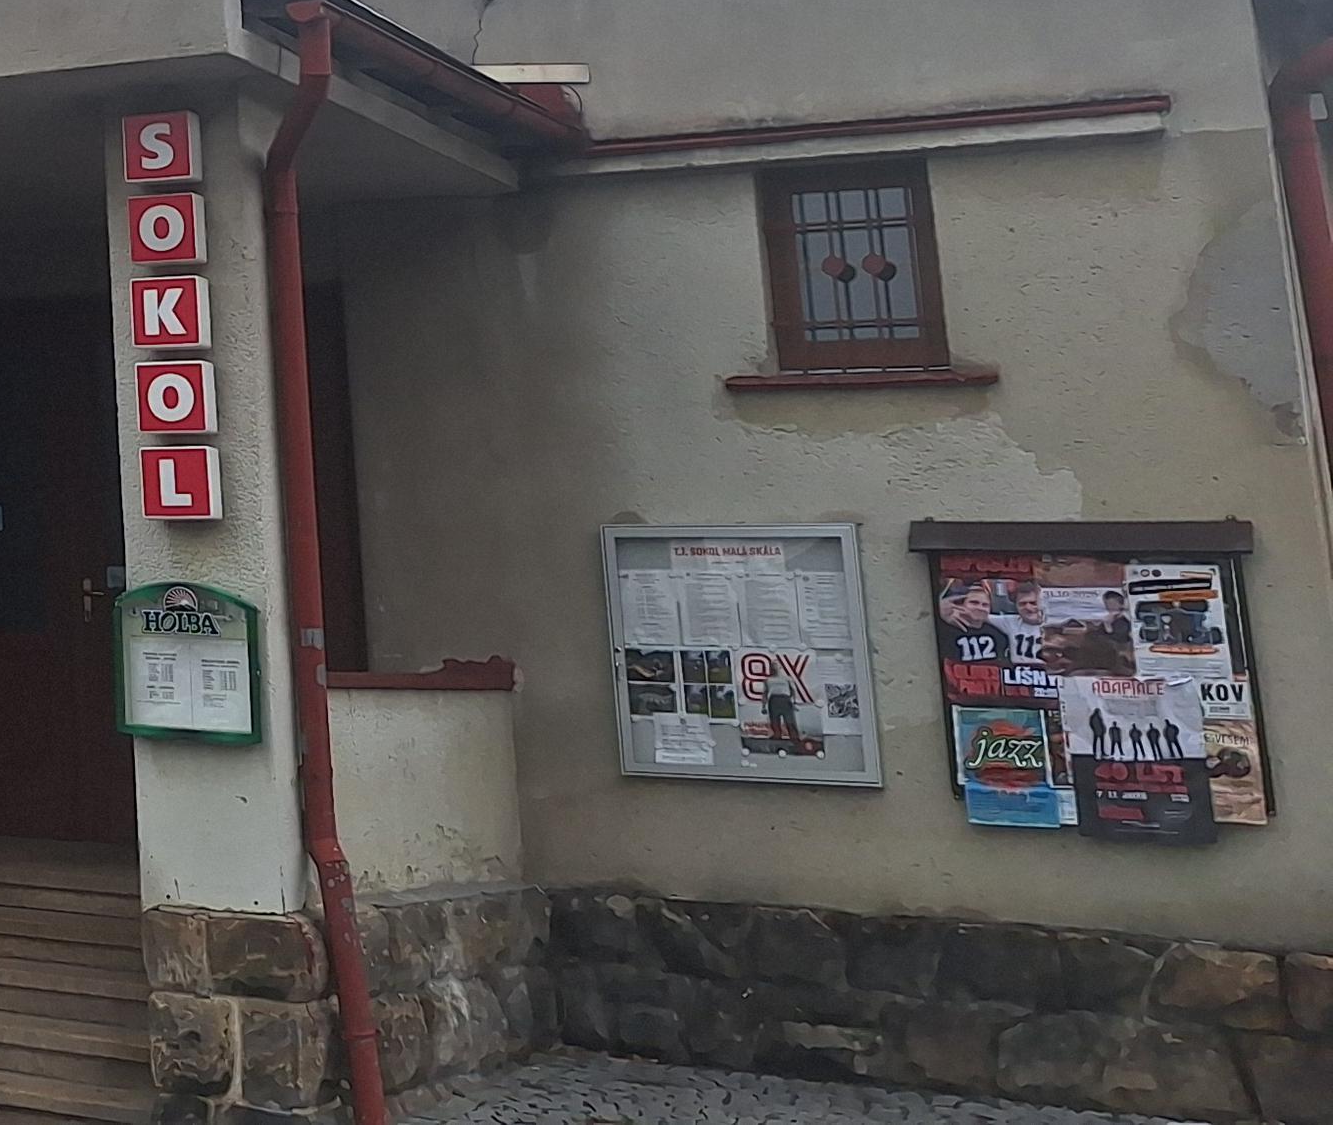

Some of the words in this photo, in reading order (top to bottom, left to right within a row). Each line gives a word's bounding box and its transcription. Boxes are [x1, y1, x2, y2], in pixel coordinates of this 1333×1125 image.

[139, 122, 194, 507] SOKOL
[691, 546, 721, 556] SOKOL
[722, 544, 748, 556] MALÁ
[749, 544, 781, 556] SKÁLA
[142, 610, 220, 636] HOLBA
[956, 636, 996, 661] 112
[967, 730, 1044, 768] jazz
